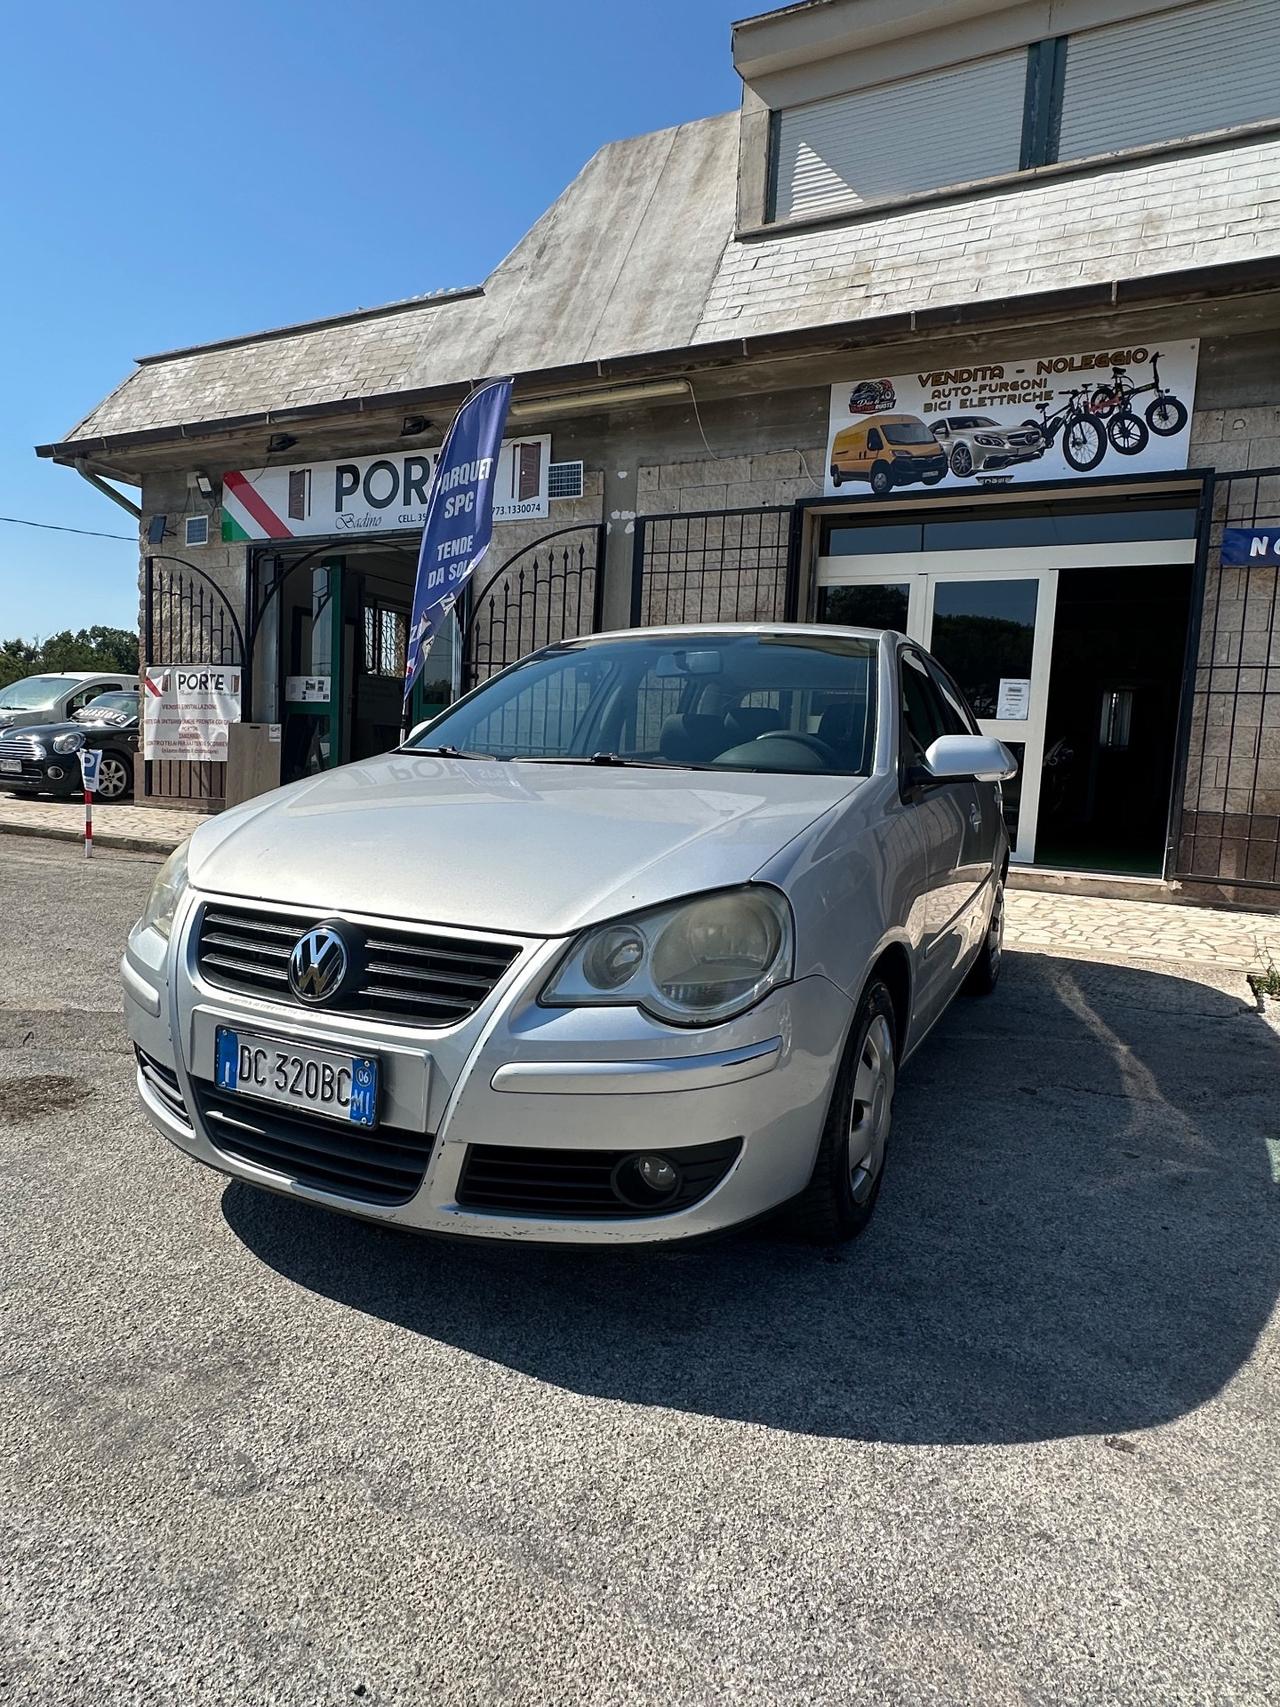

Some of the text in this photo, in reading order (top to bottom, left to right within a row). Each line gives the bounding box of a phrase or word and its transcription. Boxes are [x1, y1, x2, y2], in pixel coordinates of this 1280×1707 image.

[918, 365, 1005, 388] VENDITA
[1036, 348, 1149, 375] NOLEGGIO
[923, 389, 1054, 413] BICI ELETTRICHE
[931, 378, 1048, 400] AUTO-FURGONI
[335, 453, 440, 512] POR
[440, 457, 494, 495] ARQUET
[397, 514, 416, 523] CELL.
[418, 512, 427, 521] 35
[445, 491, 475, 519] SPC
[437, 535, 474, 562] TENDE
[428, 566, 445, 590] DA
[178, 673, 225, 691] PORTE
[239, 1044, 268, 1086] DC
[358, 1071, 370, 1083] 06
[274, 1052, 352, 1107] 320BC
[351, 1089, 370, 1116] MI
